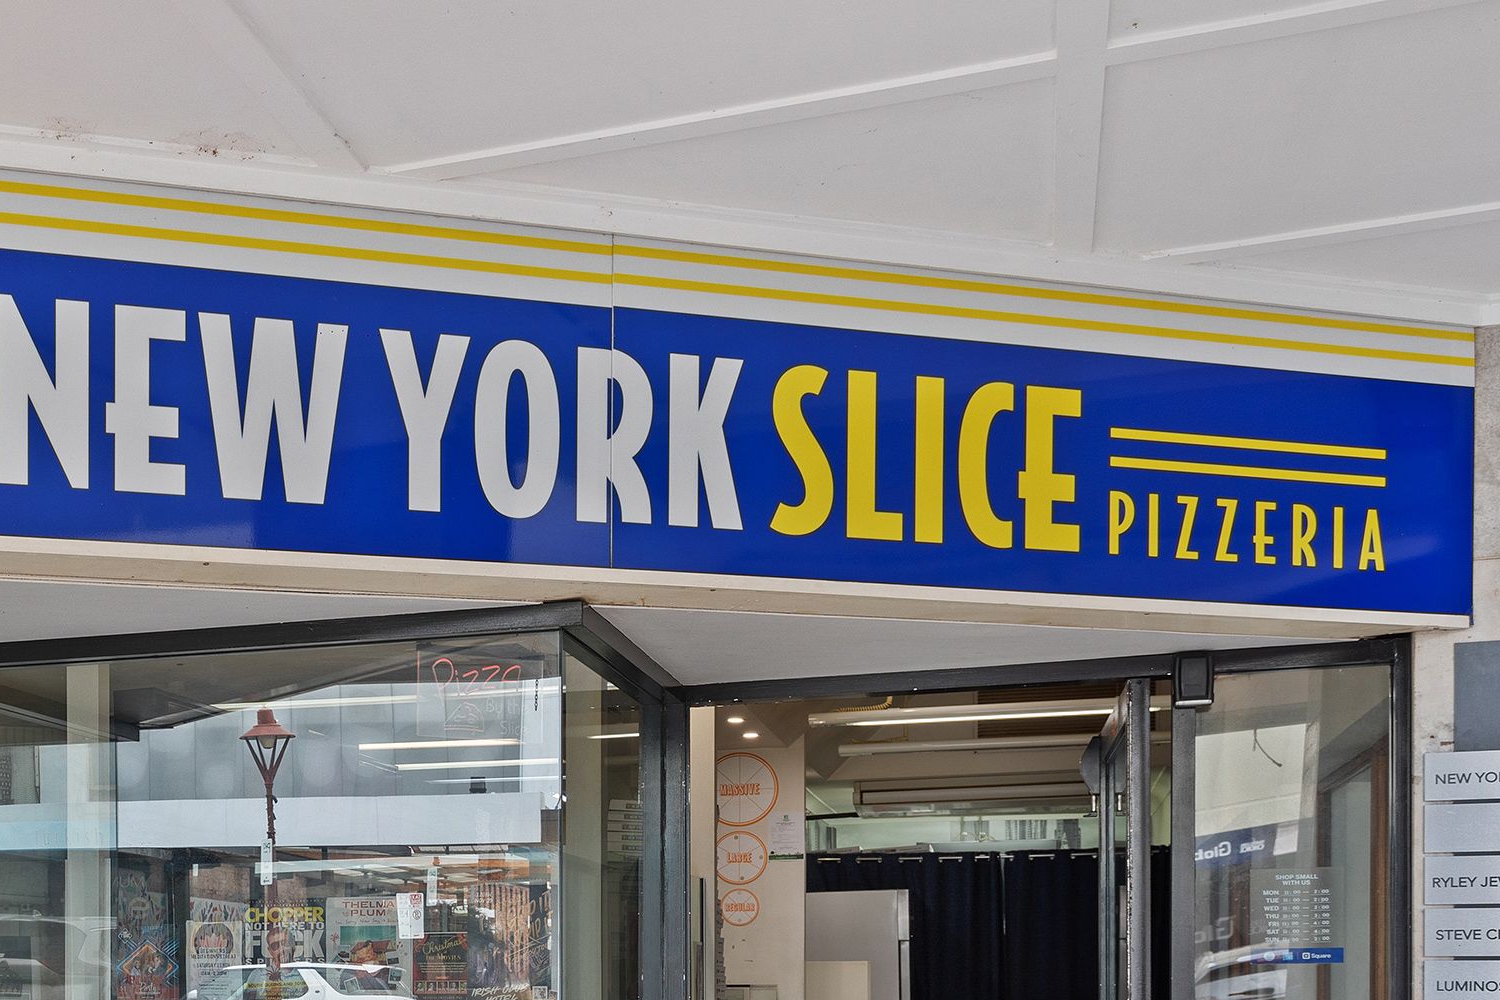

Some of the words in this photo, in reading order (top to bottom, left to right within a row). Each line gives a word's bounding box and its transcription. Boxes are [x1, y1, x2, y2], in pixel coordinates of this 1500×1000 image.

[379, 328, 744, 530] YORK
[770, 364, 1082, 553] SLICE
[1109, 490, 1386, 572] PIZZERIA
[432, 658, 521, 707] Pizza
[1435, 773, 1471, 785] NEW
[1475, 771, 1500, 783] YO
[720, 783, 760, 796] MASSIVE
[727, 852, 752, 864] LARGE
[1432, 876, 1477, 888] RYLEY
[342, 901, 396, 909] THELMA
[725, 903, 755, 912] REGULAR
[245, 906, 324, 923] CHOPPER
[350, 909, 386, 917] PLUM
[245, 921, 267, 931] NOT
[311, 921, 324, 930] TO
[1435, 929, 1482, 940] STEVE
